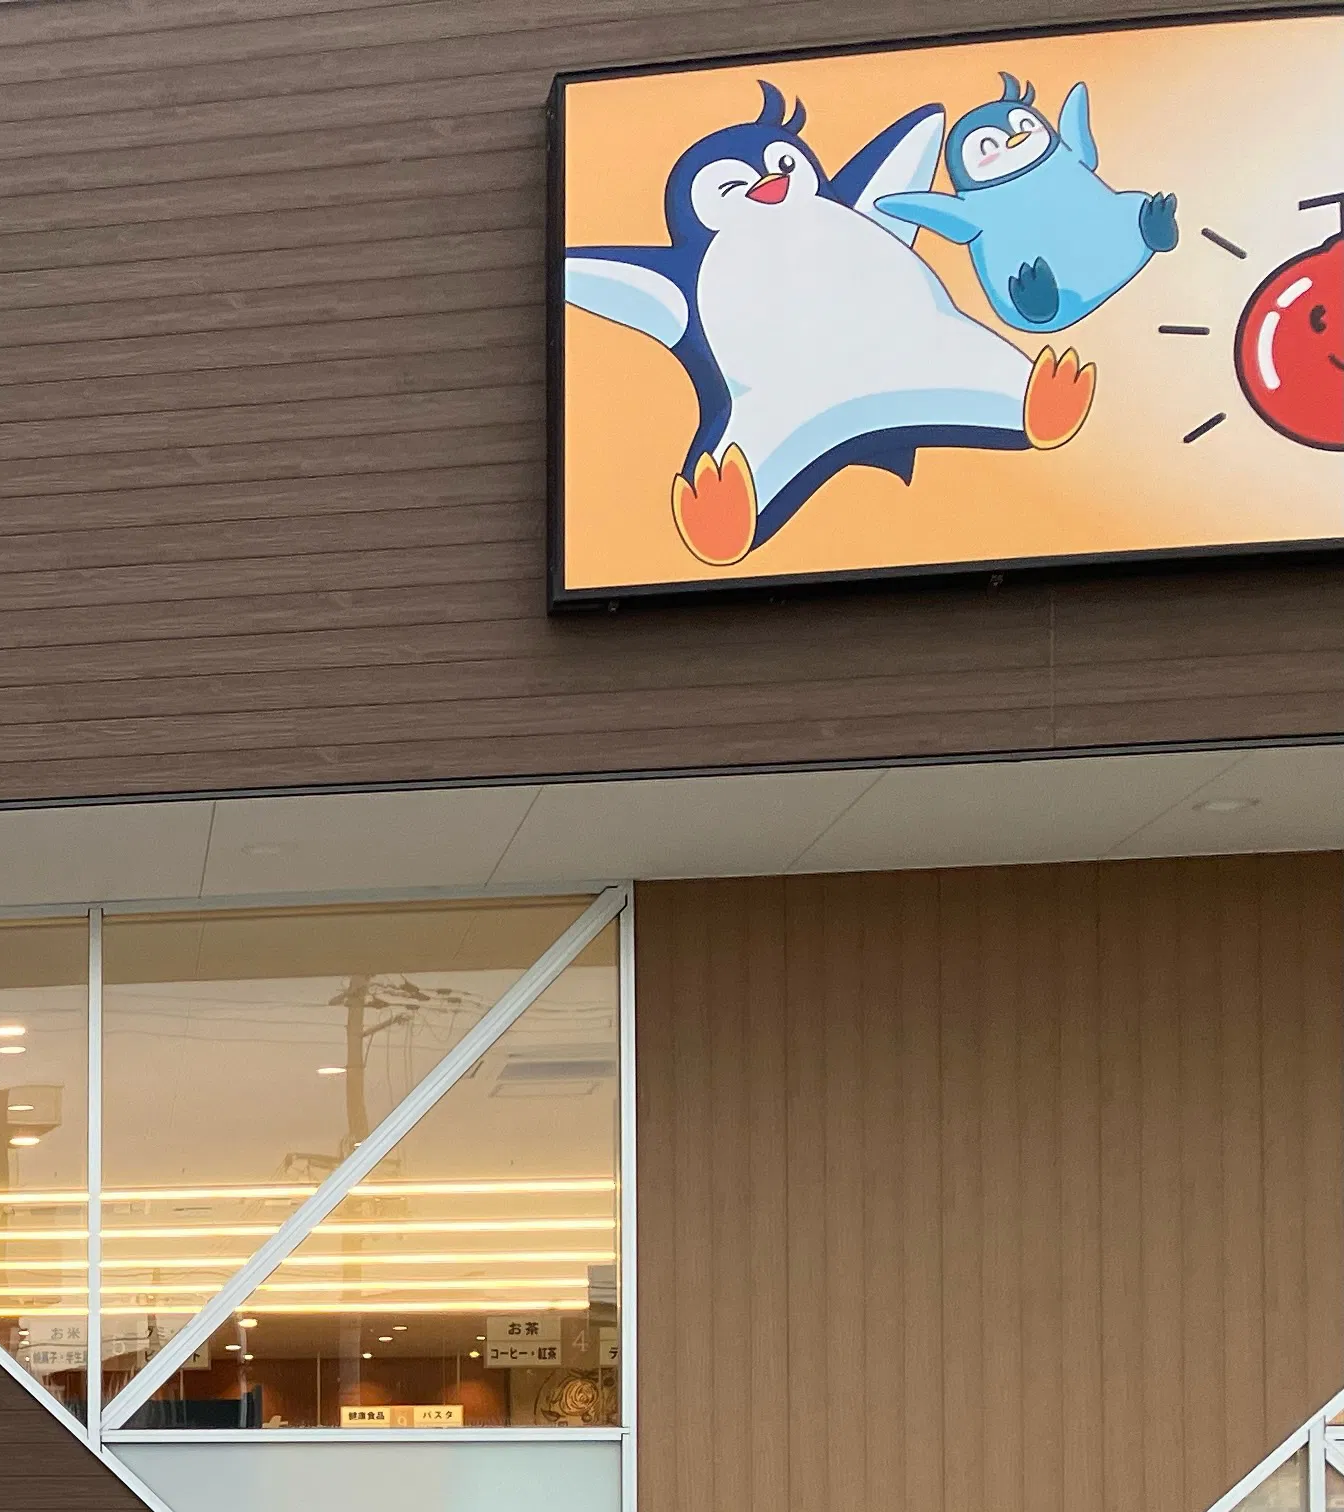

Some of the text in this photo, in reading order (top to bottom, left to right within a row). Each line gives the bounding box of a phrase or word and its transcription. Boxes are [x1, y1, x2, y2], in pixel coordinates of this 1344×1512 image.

[508, 1321, 539, 1336] お茶
[422, 1410, 453, 1419] パスタ
